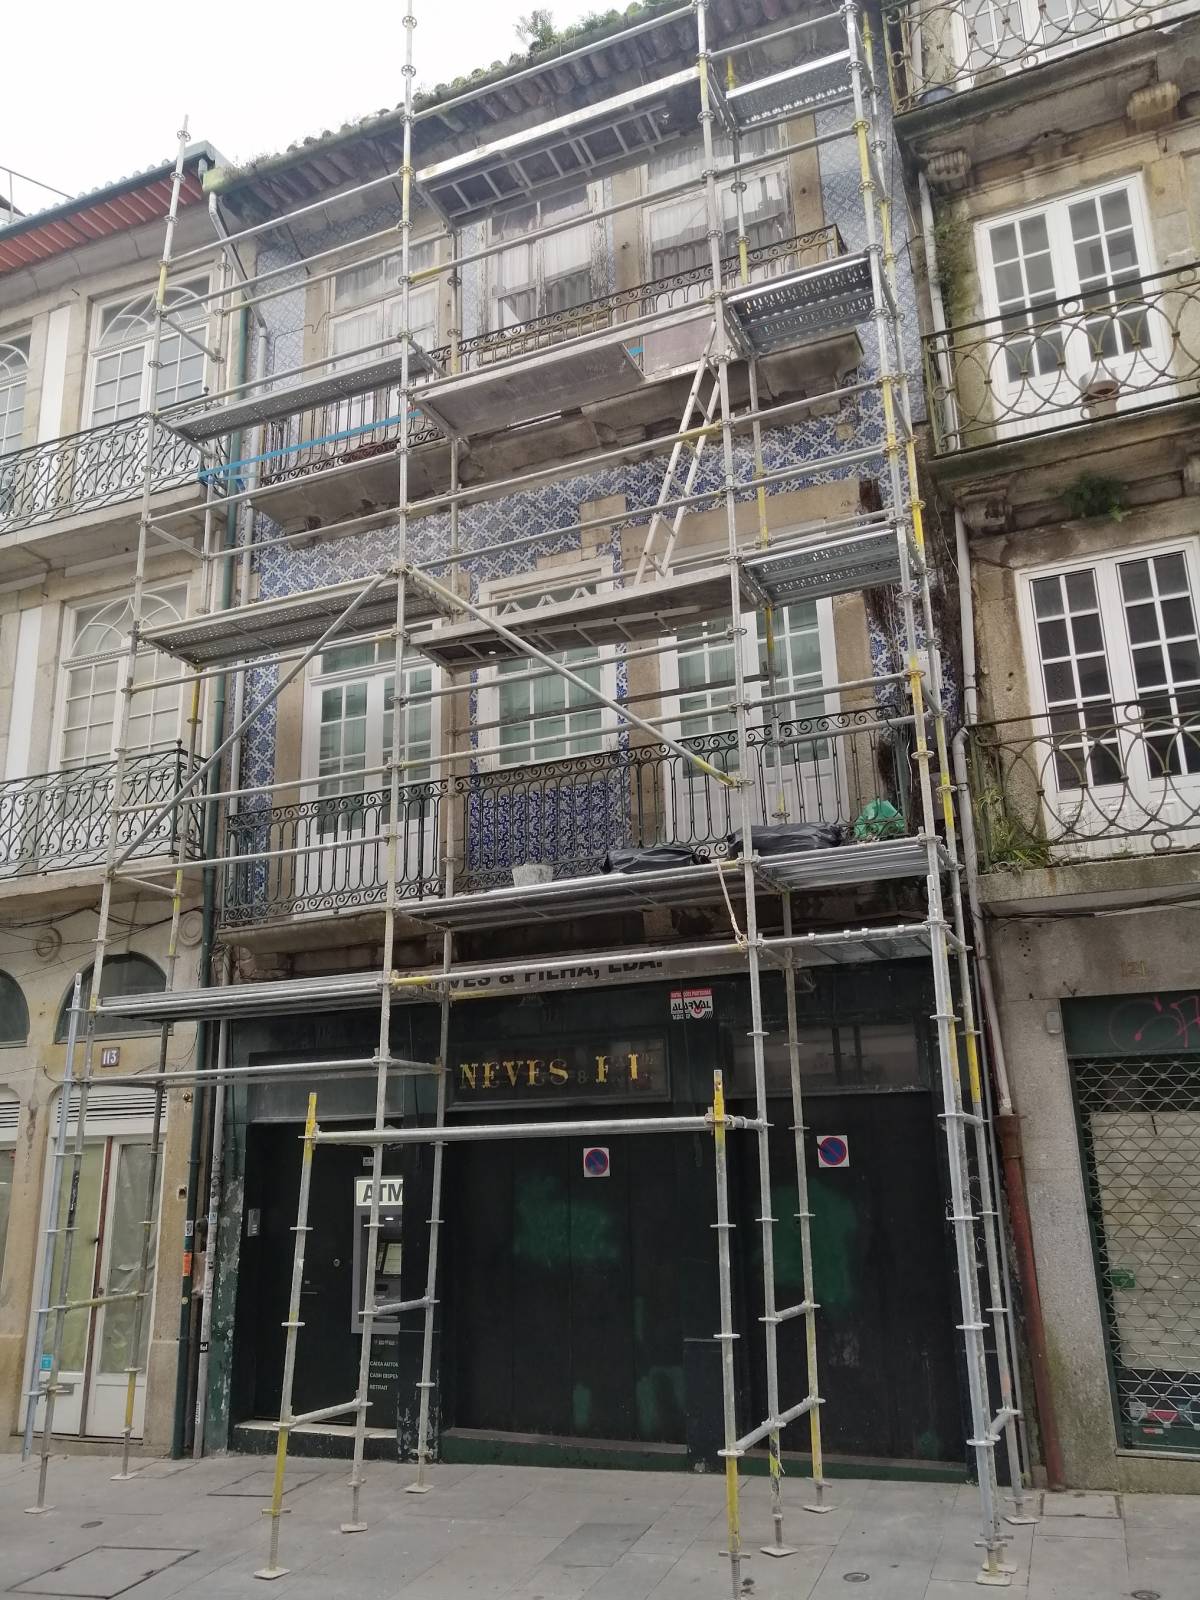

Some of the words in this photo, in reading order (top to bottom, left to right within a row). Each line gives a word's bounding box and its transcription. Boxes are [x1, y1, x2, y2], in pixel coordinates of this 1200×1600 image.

[102, 1049, 117, 1065] 113
[459, 1058, 569, 1089] NEVES
[362, 1183, 404, 1203] ATM
